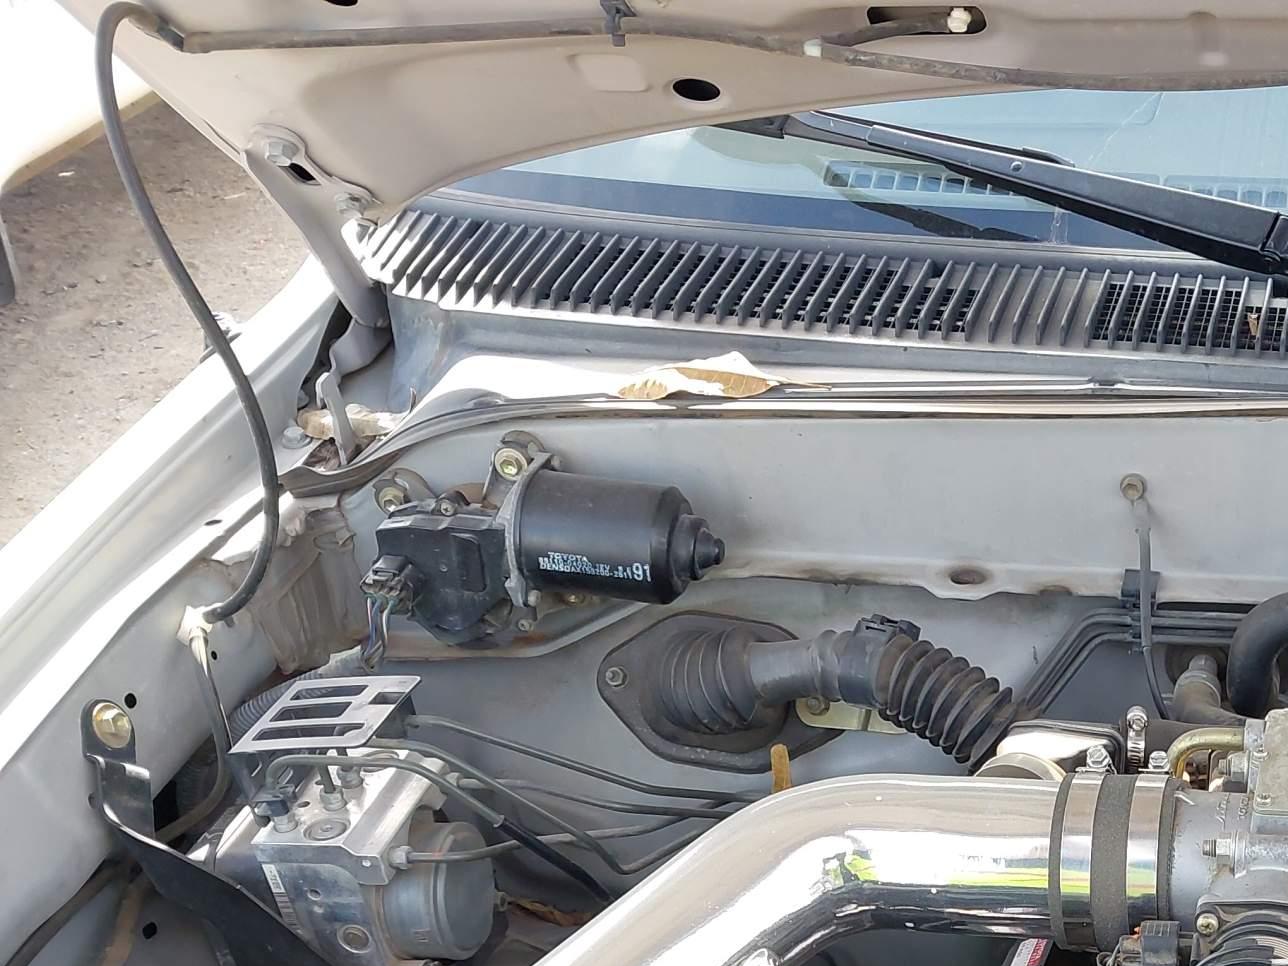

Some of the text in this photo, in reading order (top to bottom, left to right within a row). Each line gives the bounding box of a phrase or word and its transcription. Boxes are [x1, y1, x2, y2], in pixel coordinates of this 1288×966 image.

[547, 551, 589, 562] TOYOTA
[540, 561, 572, 573] DENSO
[631, 562, 652, 582] 91
